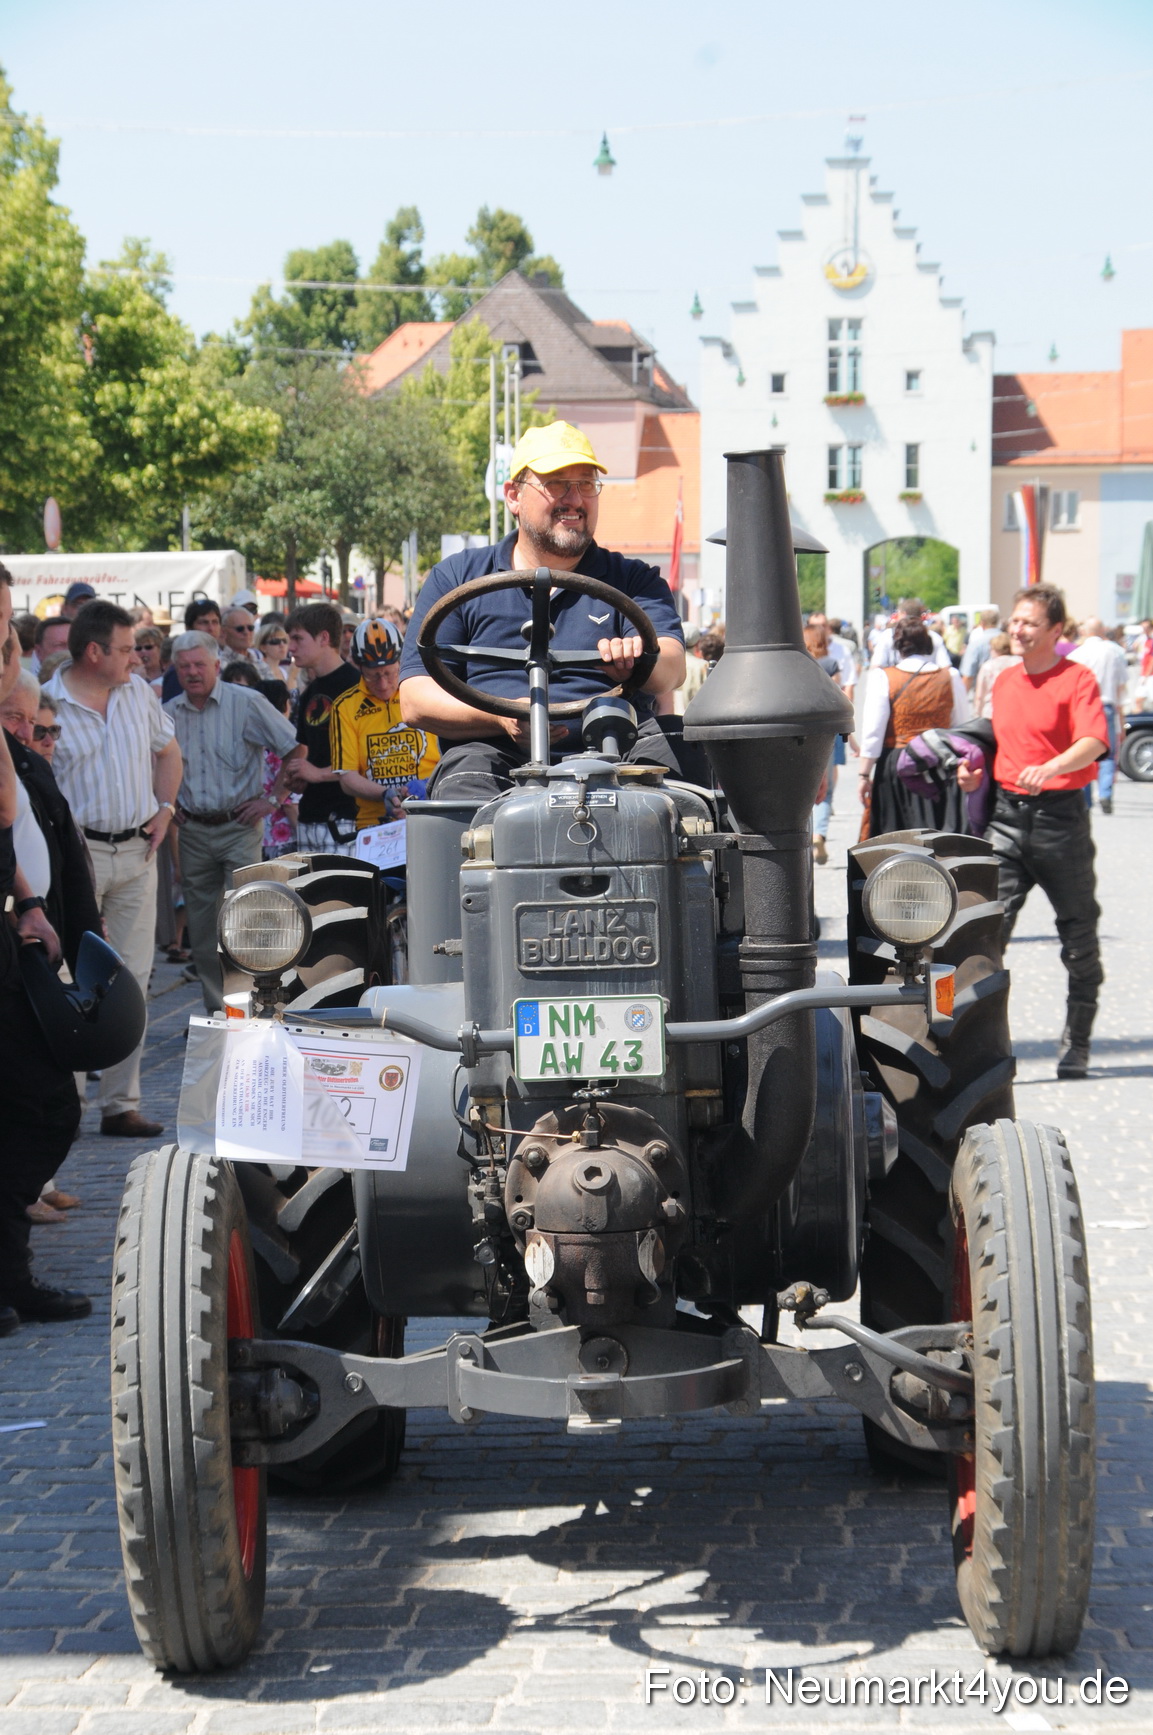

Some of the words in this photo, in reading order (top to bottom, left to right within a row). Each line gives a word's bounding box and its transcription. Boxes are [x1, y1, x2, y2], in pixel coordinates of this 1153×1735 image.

[354, 707, 382, 720] adidas
[370, 734, 414, 748] WORLD
[370, 748, 400, 756] GAMES
[401, 744, 415, 752] OF
[371, 756, 415, 766] MOUNTAIN
[373, 764, 415, 777] BIKING
[374, 776, 418, 785] AALBACH
[548, 909, 626, 936] LANZ
[522, 936, 652, 964] BULLDOG
[549, 1004, 595, 1037] NM
[524, 1024, 532, 1034] D
[540, 1042, 583, 1075] AW
[600, 1040, 642, 1073] 43
